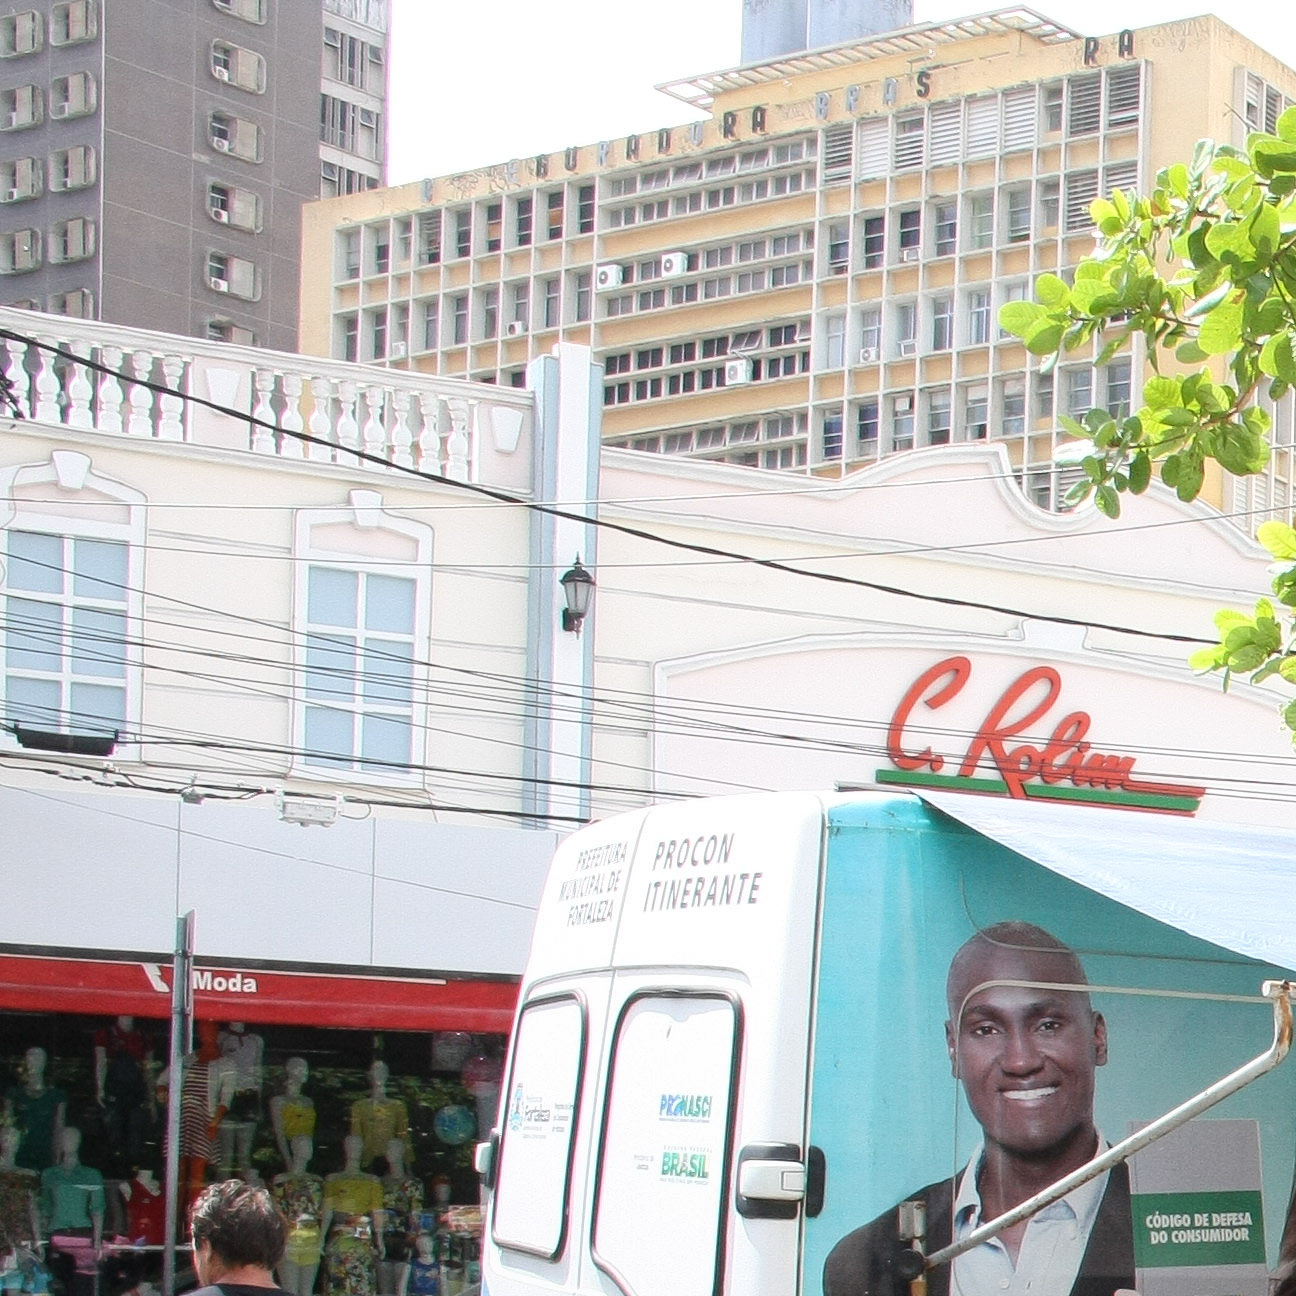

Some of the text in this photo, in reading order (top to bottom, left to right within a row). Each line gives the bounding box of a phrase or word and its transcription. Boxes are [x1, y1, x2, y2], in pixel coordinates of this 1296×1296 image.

[652, 832, 735, 873] PROCON
[643, 872, 763, 912] ITINERANTE
[193, 971, 258, 993] Moda
[661, 1151, 710, 1179] BRASIL
[1146, 1211, 1253, 1228] CÓDIGO DE DEFESA
[1150, 1227, 1250, 1245] DO CONSUMIDOR
